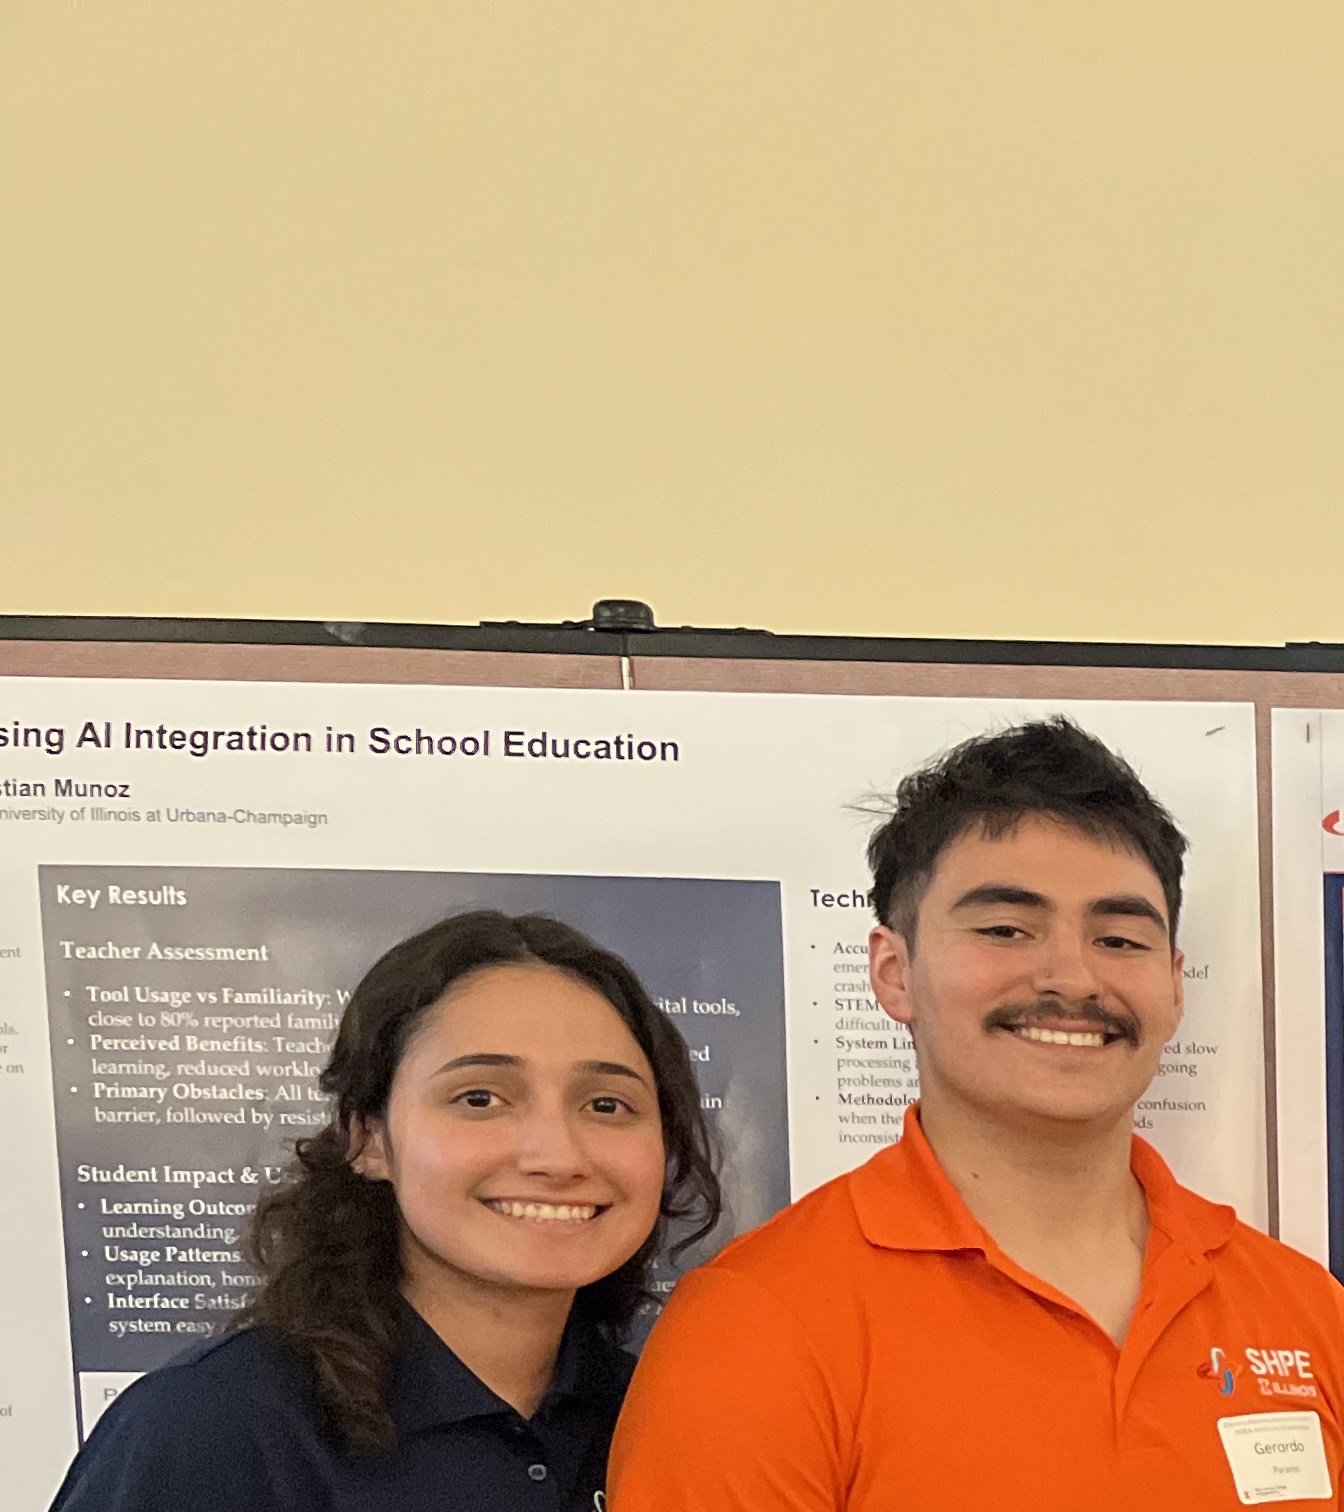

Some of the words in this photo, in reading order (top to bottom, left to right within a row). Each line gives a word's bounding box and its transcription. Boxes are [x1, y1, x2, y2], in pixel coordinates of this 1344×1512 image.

[76, 721, 111, 748] AI
[124, 722, 311, 759] Integration
[326, 726, 354, 752] in
[368, 727, 489, 756] School
[503, 730, 678, 761] Education
[0, 778, 45, 797] tian
[54, 778, 130, 798] Munoz
[0, 806, 65, 824] niversity
[56, 884, 101, 909] Key
[108, 884, 187, 905] Results
[692, 997, 740, 1016] tools,
[1245, 1347, 1314, 1379] SHPE
[1254, 1440, 1305, 1455] Gerardo
